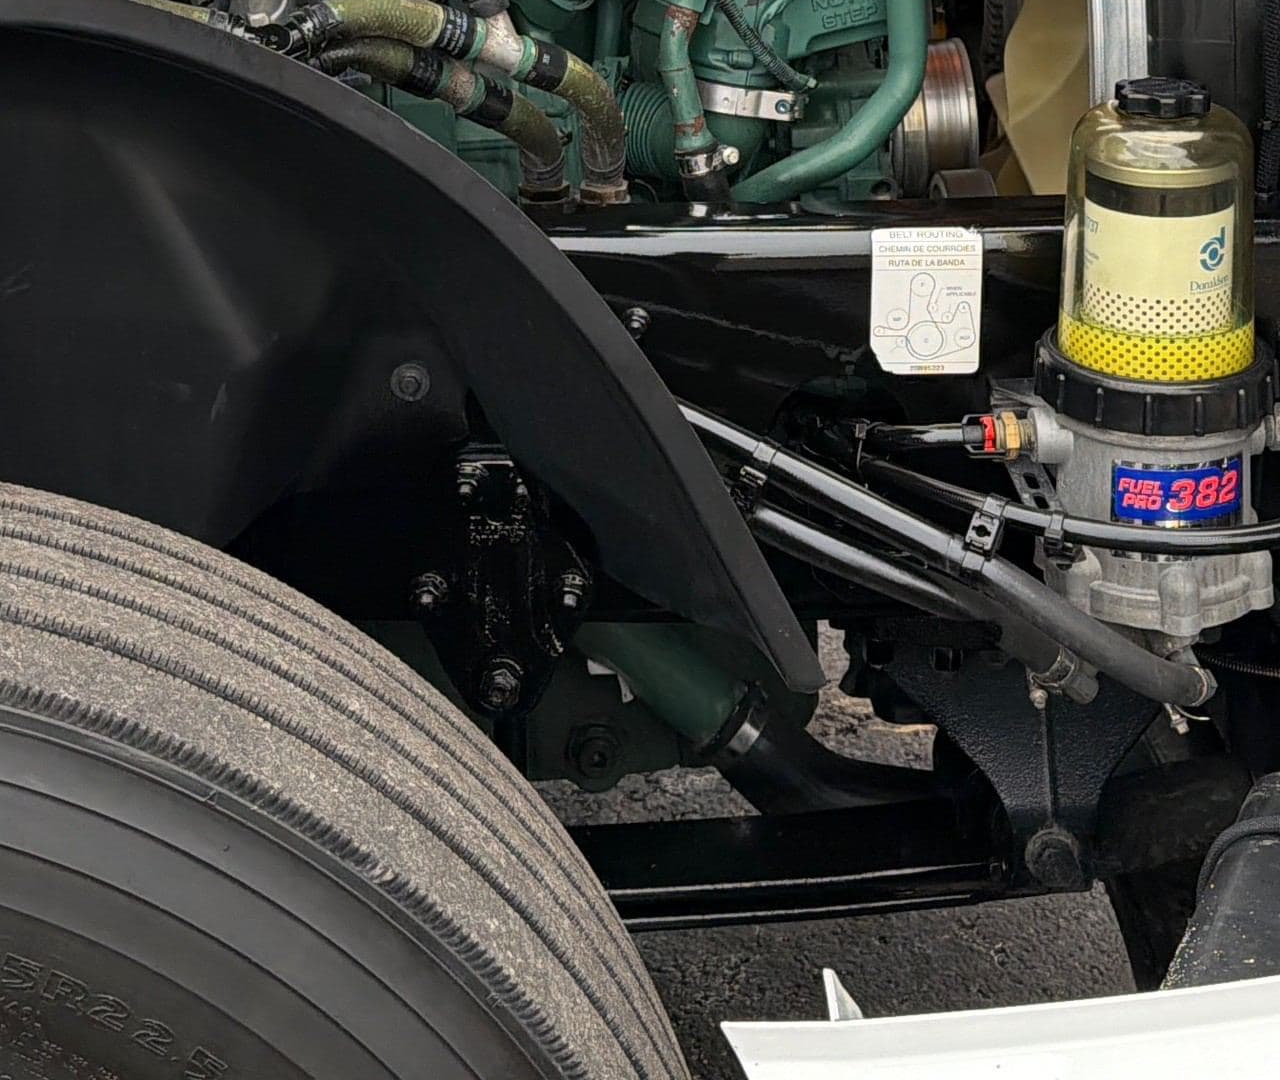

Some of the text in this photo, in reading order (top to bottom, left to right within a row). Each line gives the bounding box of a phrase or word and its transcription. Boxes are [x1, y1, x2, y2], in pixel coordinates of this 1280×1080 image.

[822, 3, 879, 30] STEP
[889, 231, 964, 239] BELT ROUTING
[878, 244, 976, 253] CHEMIN DE COURROIES
[888, 259, 966, 267] RUTA DE LA BANDA
[1117, 471, 1238, 512] FUEL 382
[1121, 493, 1163, 511] PRO
